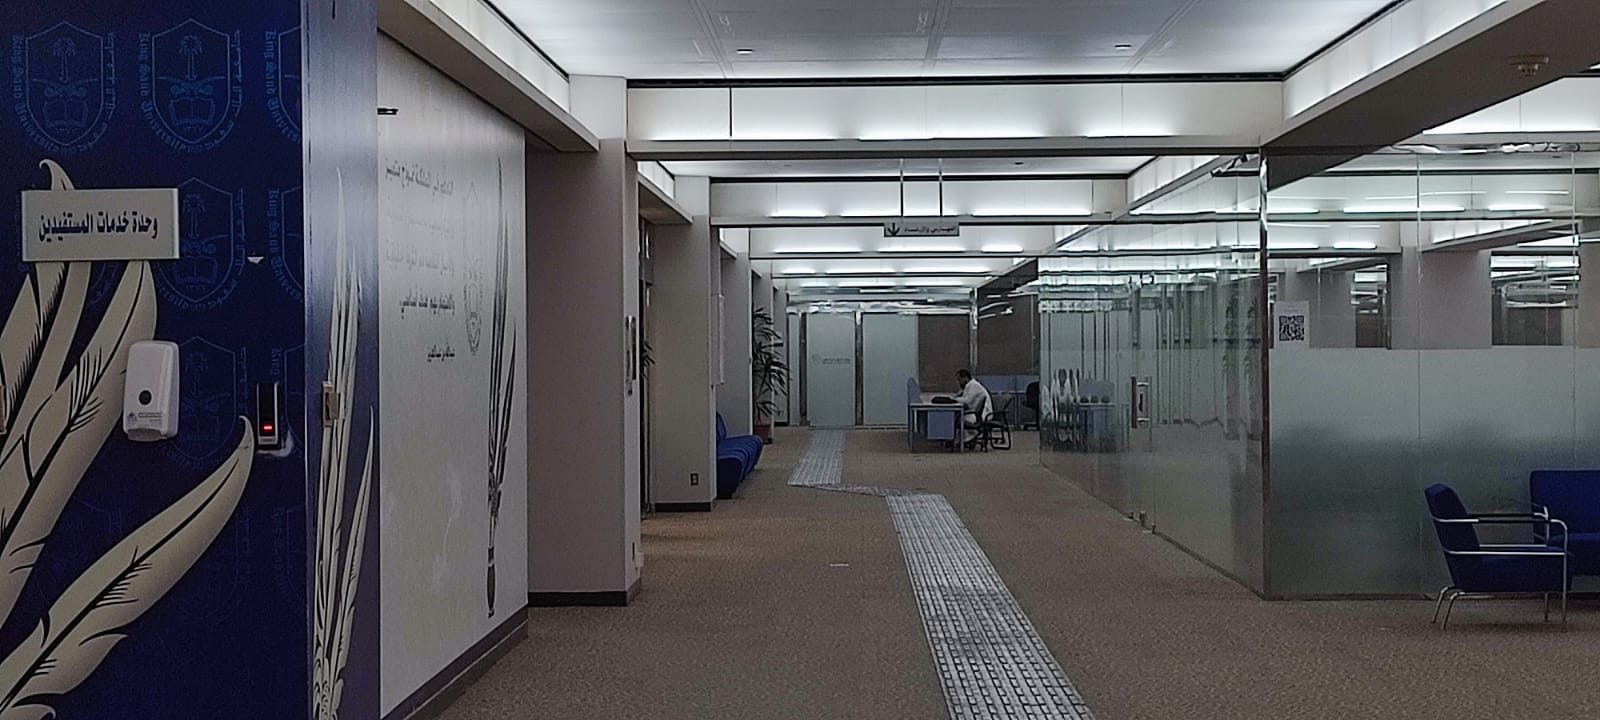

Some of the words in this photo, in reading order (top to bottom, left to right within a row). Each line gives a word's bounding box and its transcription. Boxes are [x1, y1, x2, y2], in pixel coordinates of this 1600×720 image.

[38, 210, 94, 242] المستفيدين
[97, 210, 129, 233] خدمات
[132, 210, 158, 239] وحدة
